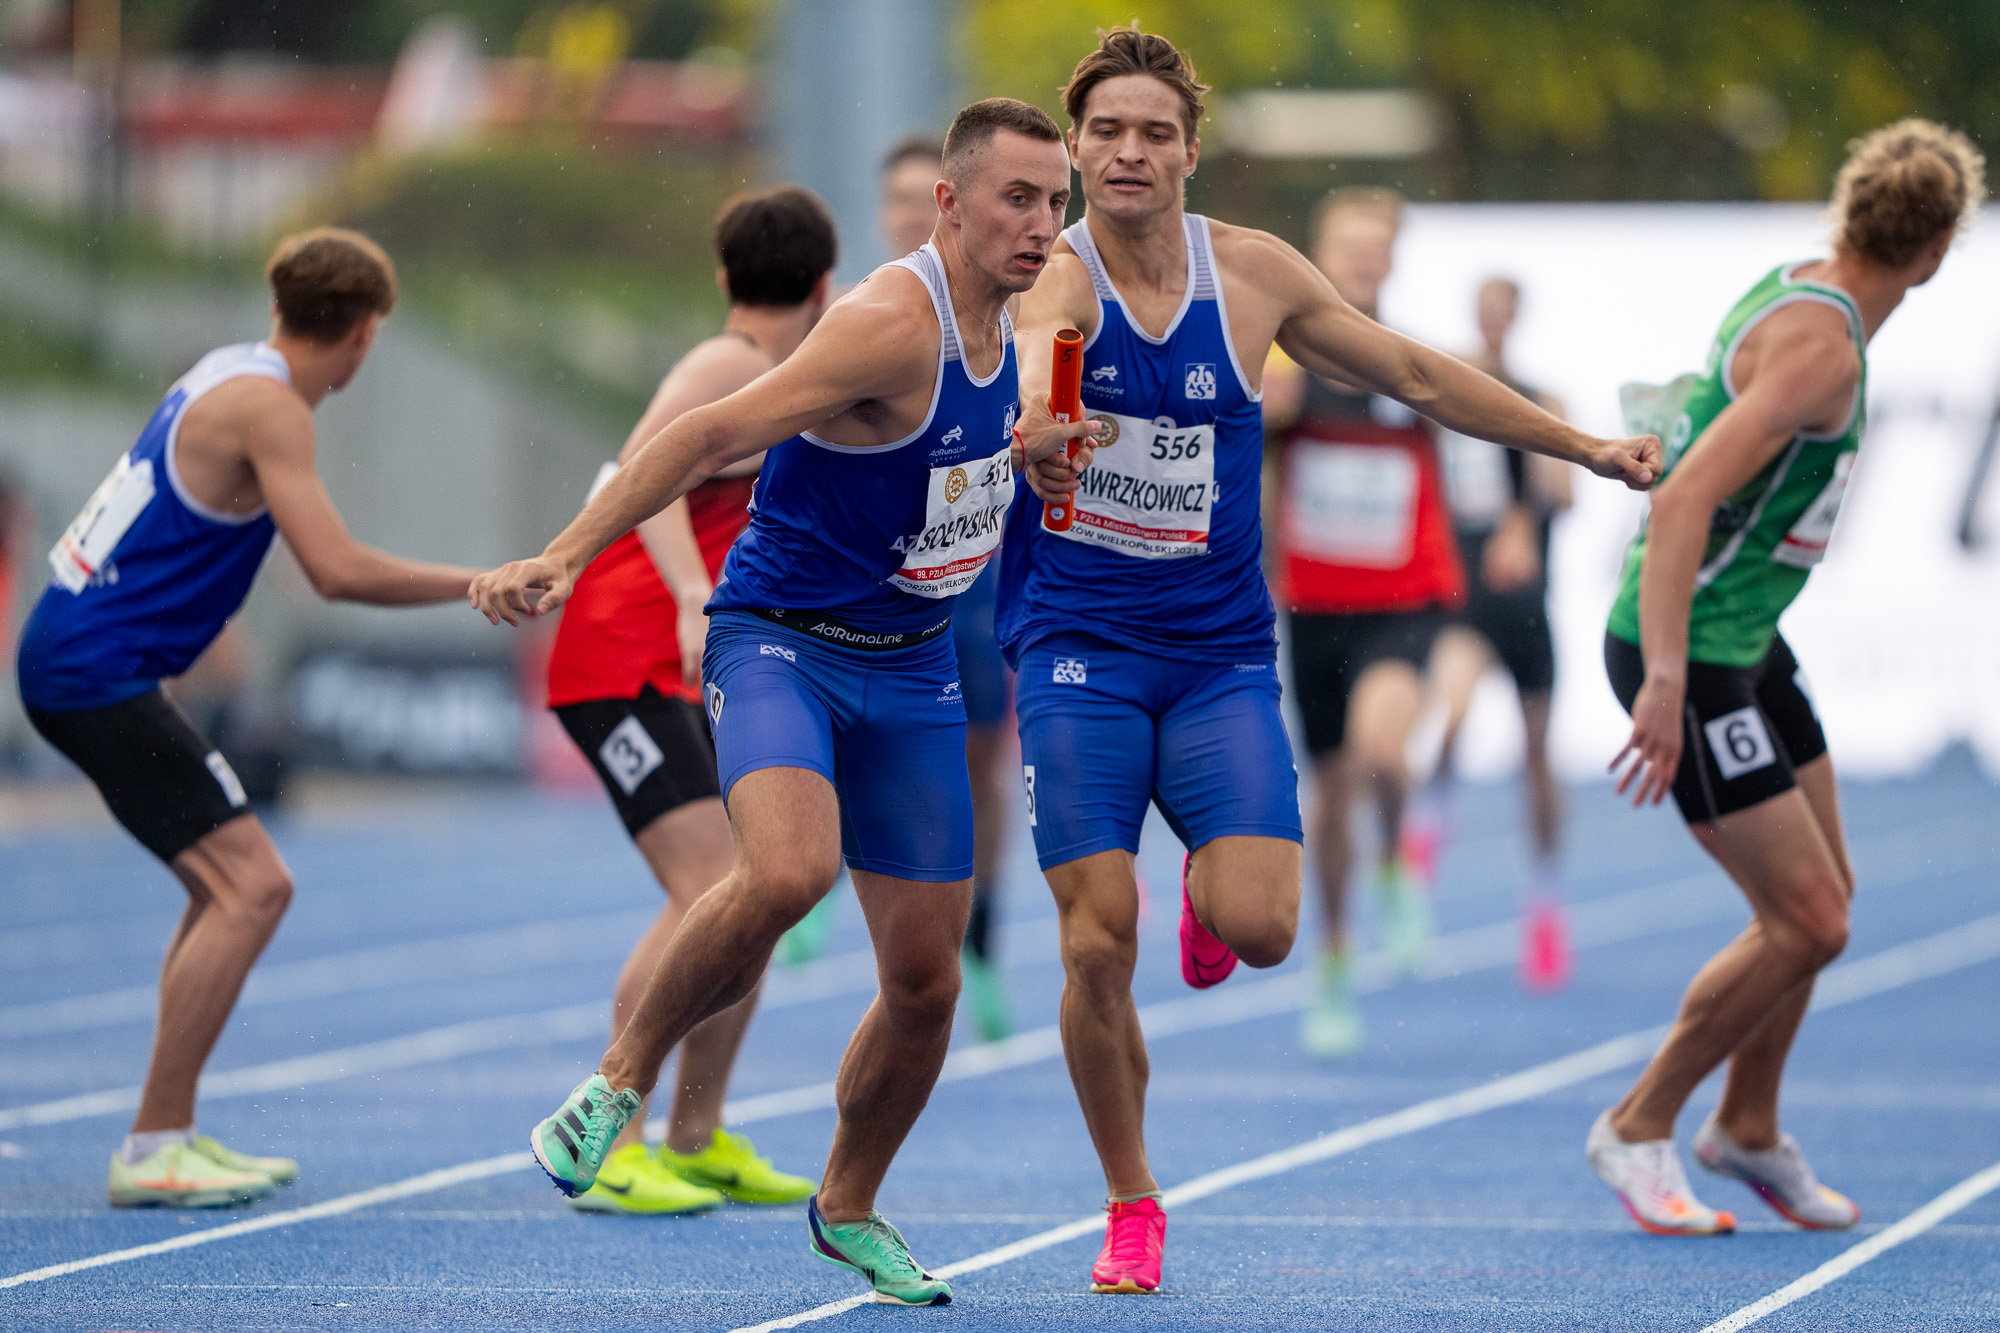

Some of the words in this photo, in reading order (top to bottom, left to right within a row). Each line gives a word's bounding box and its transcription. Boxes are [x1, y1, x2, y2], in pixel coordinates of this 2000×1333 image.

[1060, 348, 1077, 363] 5
[1150, 433, 1201, 461] 556
[981, 455, 1010, 488] 551
[1075, 467, 1206, 512] AWRZKOWICZ
[1080, 512, 1102, 526] PZLA
[1159, 530, 1188, 541] Polski
[1096, 532, 1172, 554] WIELKOPOLSKI
[1173, 546, 1199, 554] 2023
[810, 622, 904, 645] AdRunaLine
[612, 736, 644, 776] 3
[1726, 720, 1757, 763] 6
